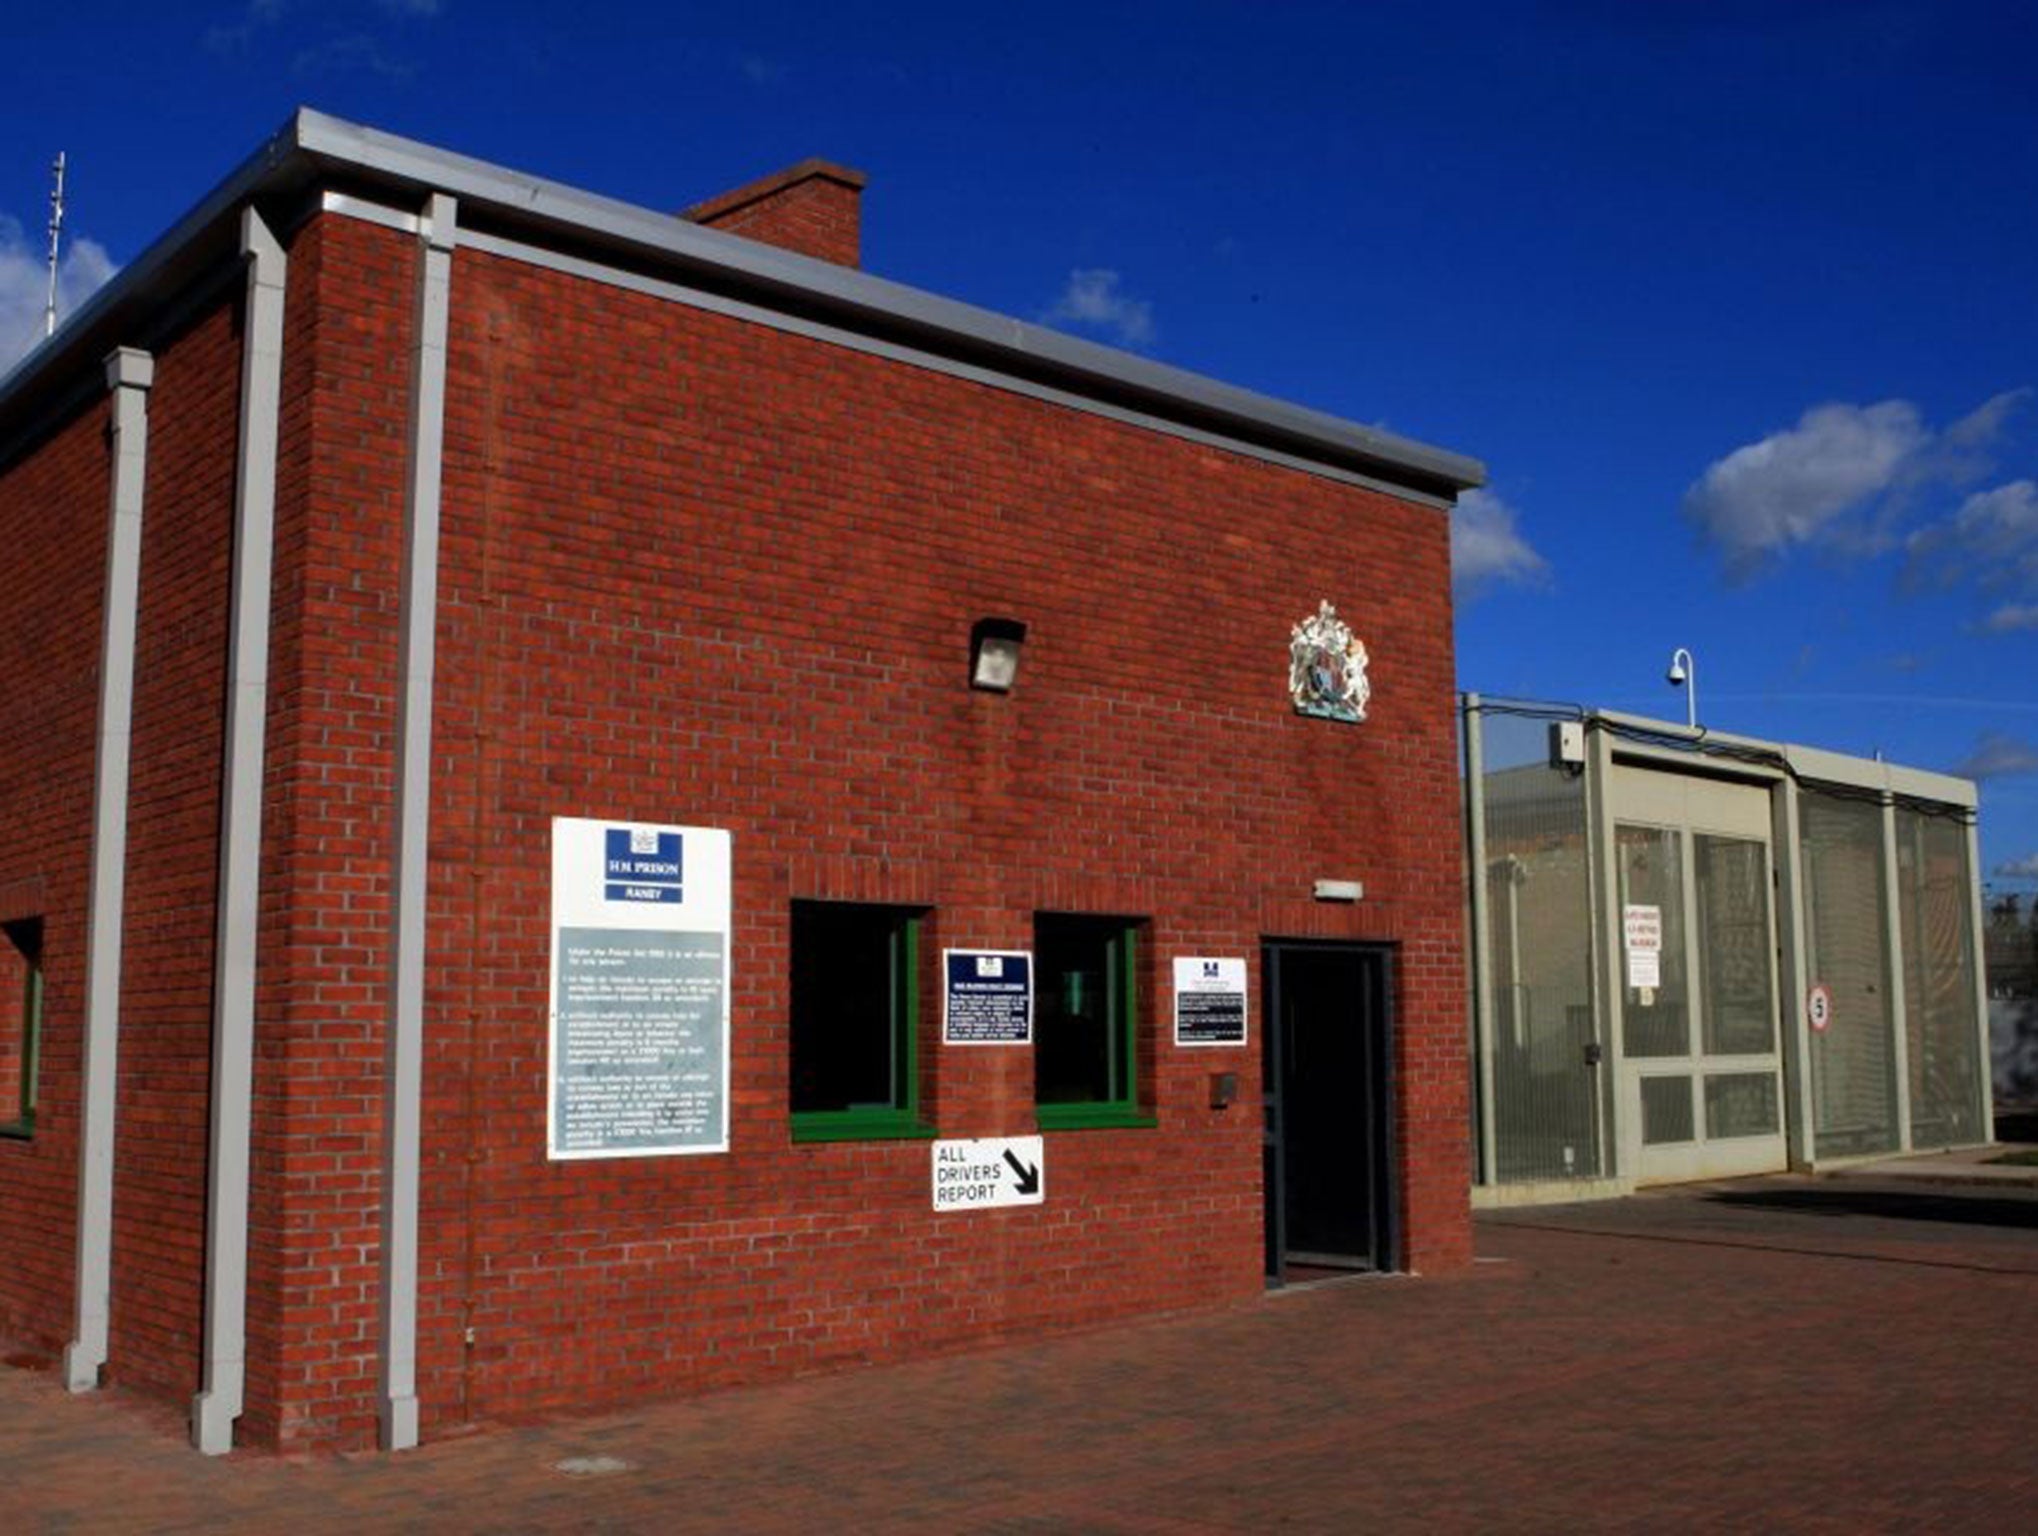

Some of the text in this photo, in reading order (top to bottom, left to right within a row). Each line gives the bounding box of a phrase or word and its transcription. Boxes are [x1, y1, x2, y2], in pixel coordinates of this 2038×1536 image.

[634, 862, 679, 875] PRISON
[1815, 997, 1824, 1018] 5
[938, 1147, 966, 1162] ALL
[938, 1164, 1001, 1183] DRIVERS
[938, 1184, 996, 1202] REPORT
